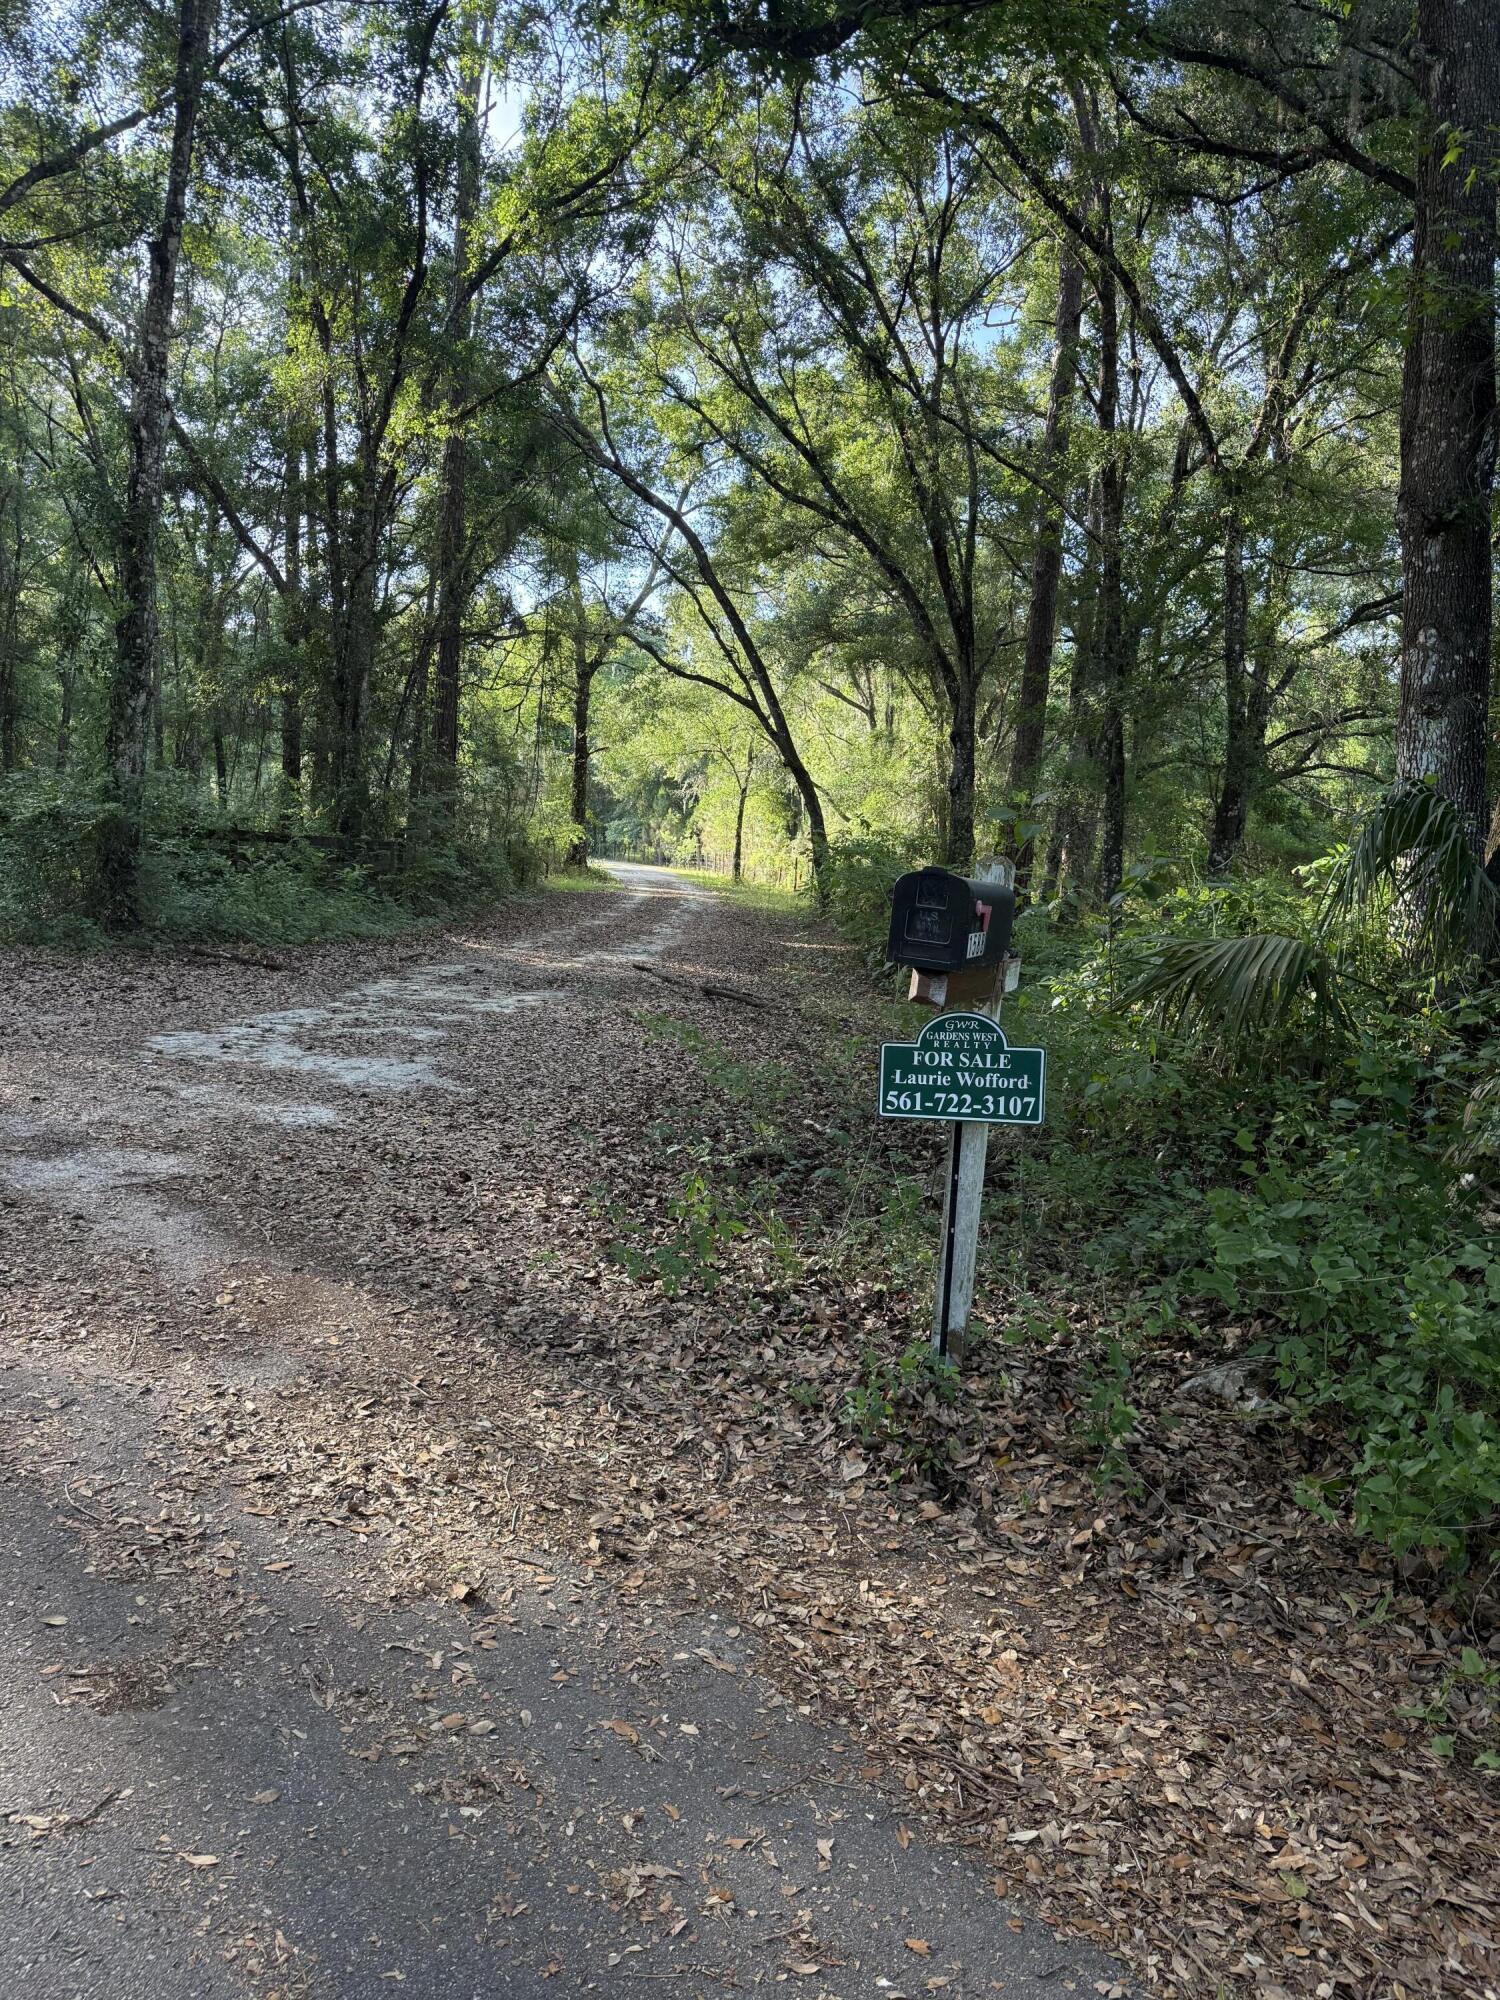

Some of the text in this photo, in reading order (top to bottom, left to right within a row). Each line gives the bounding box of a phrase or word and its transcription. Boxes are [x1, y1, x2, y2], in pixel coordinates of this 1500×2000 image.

[945, 1020, 981, 1031] GWR
[926, 1032, 998, 1042] GARDENS WEST
[933, 1041, 991, 1050] REALTY
[912, 1050, 1012, 1069] FOR SALE
[894, 1069, 1028, 1090] Laurie Wofford
[885, 1090, 1036, 1117] 561-722-3107
